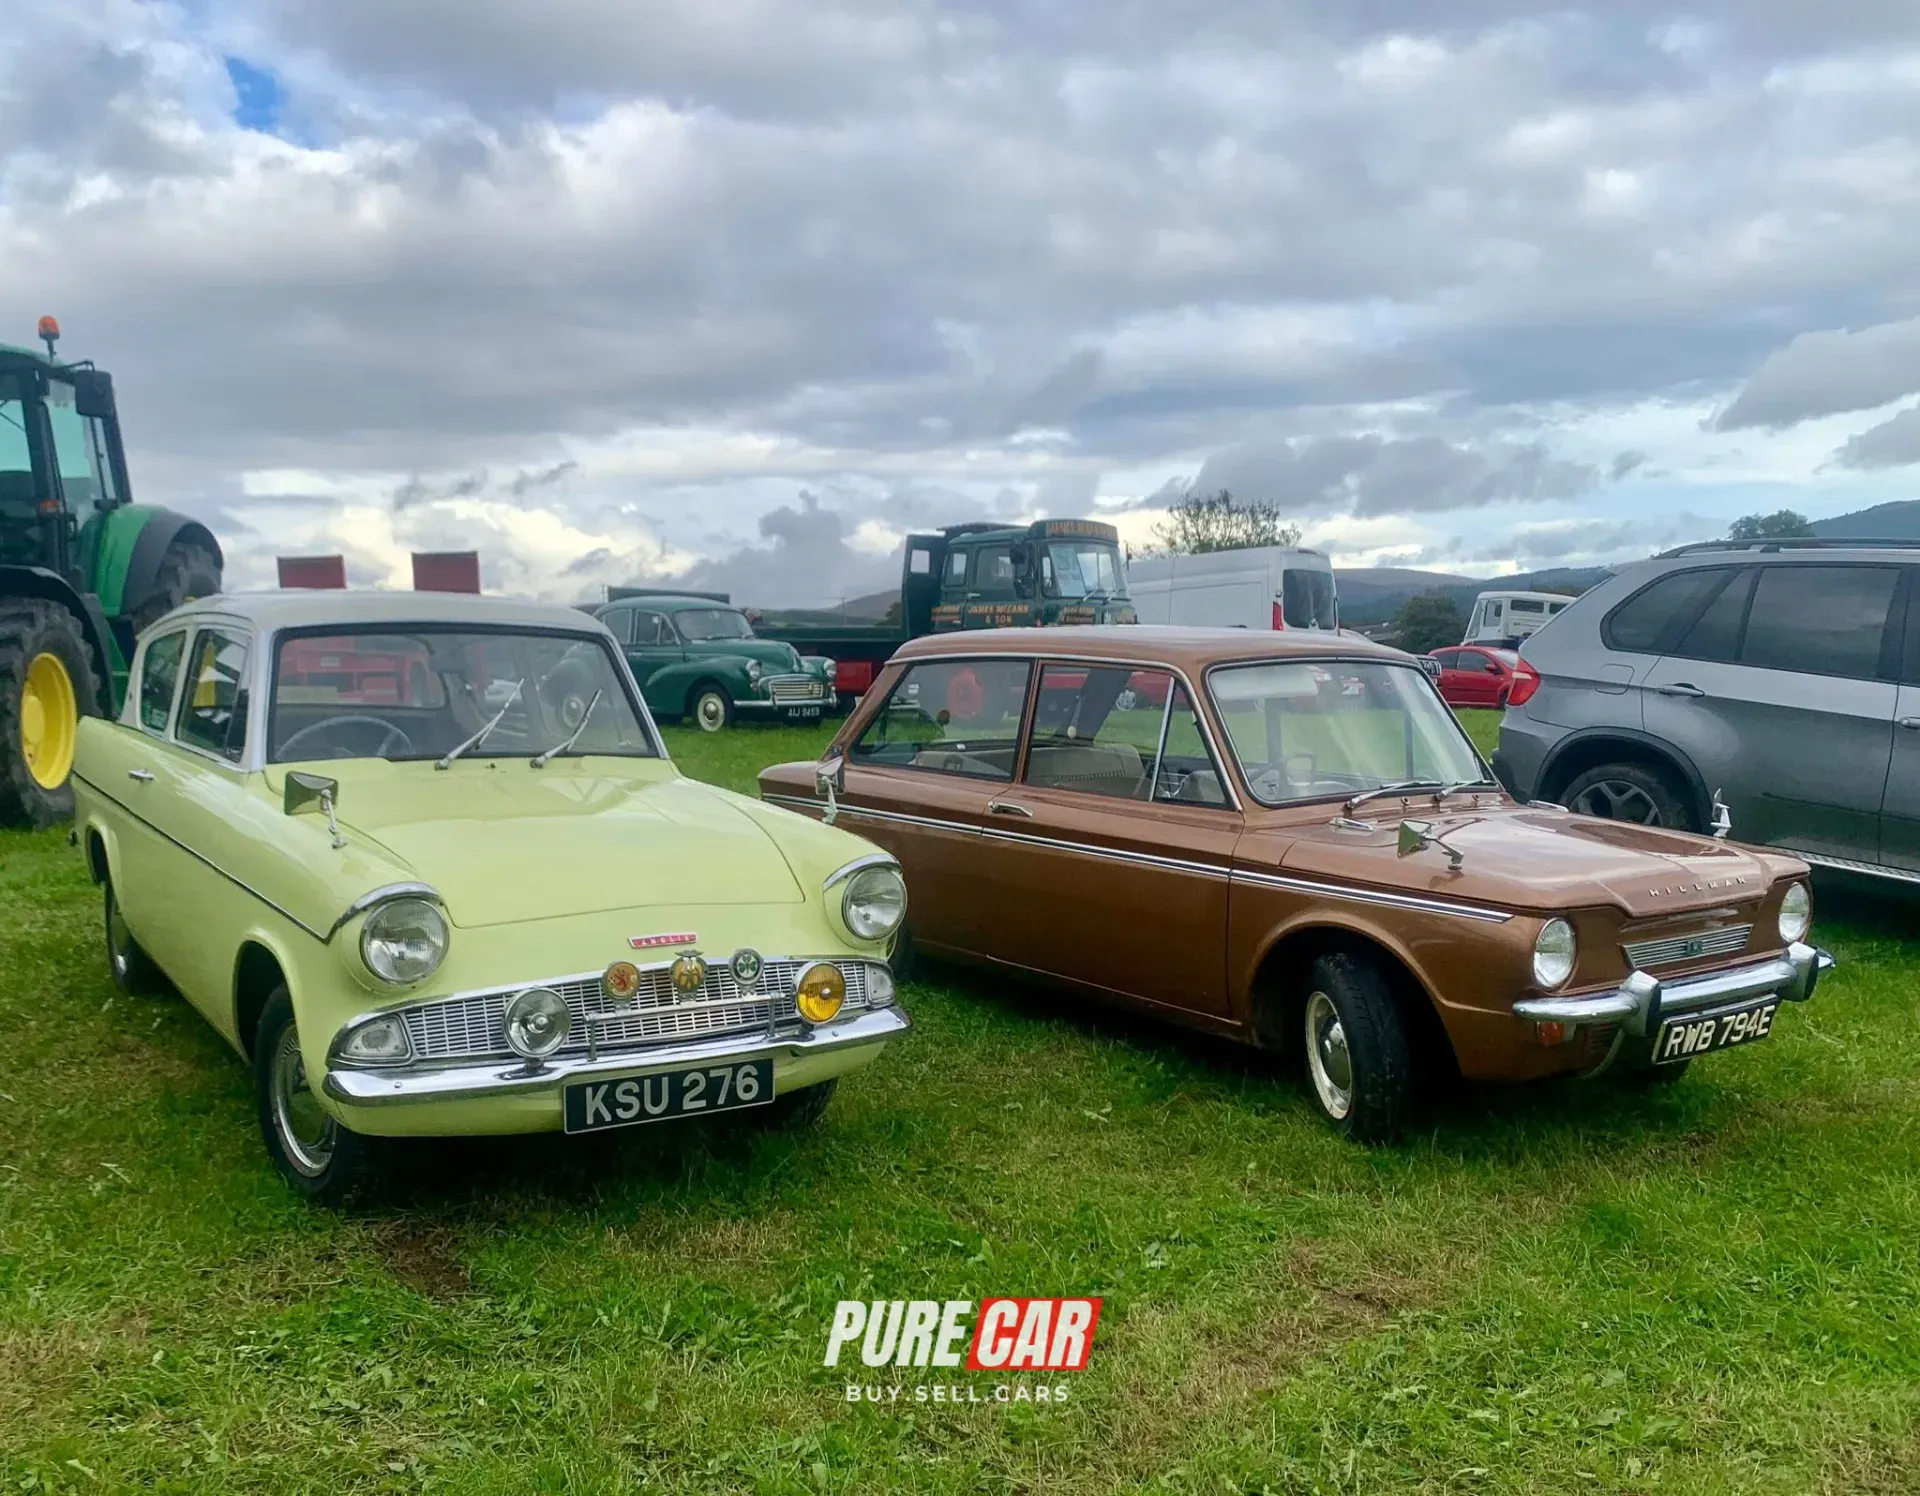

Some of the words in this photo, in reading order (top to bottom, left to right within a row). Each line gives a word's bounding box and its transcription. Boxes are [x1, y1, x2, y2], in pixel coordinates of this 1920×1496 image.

[995, 615, 1013, 625] SON
[1649, 876, 1748, 897] HILLMAN
[1664, 1021, 1717, 1058] RWB
[1718, 1005, 1776, 1046] 794E
[586, 1075, 669, 1125] KSU
[682, 1064, 759, 1110] 276
